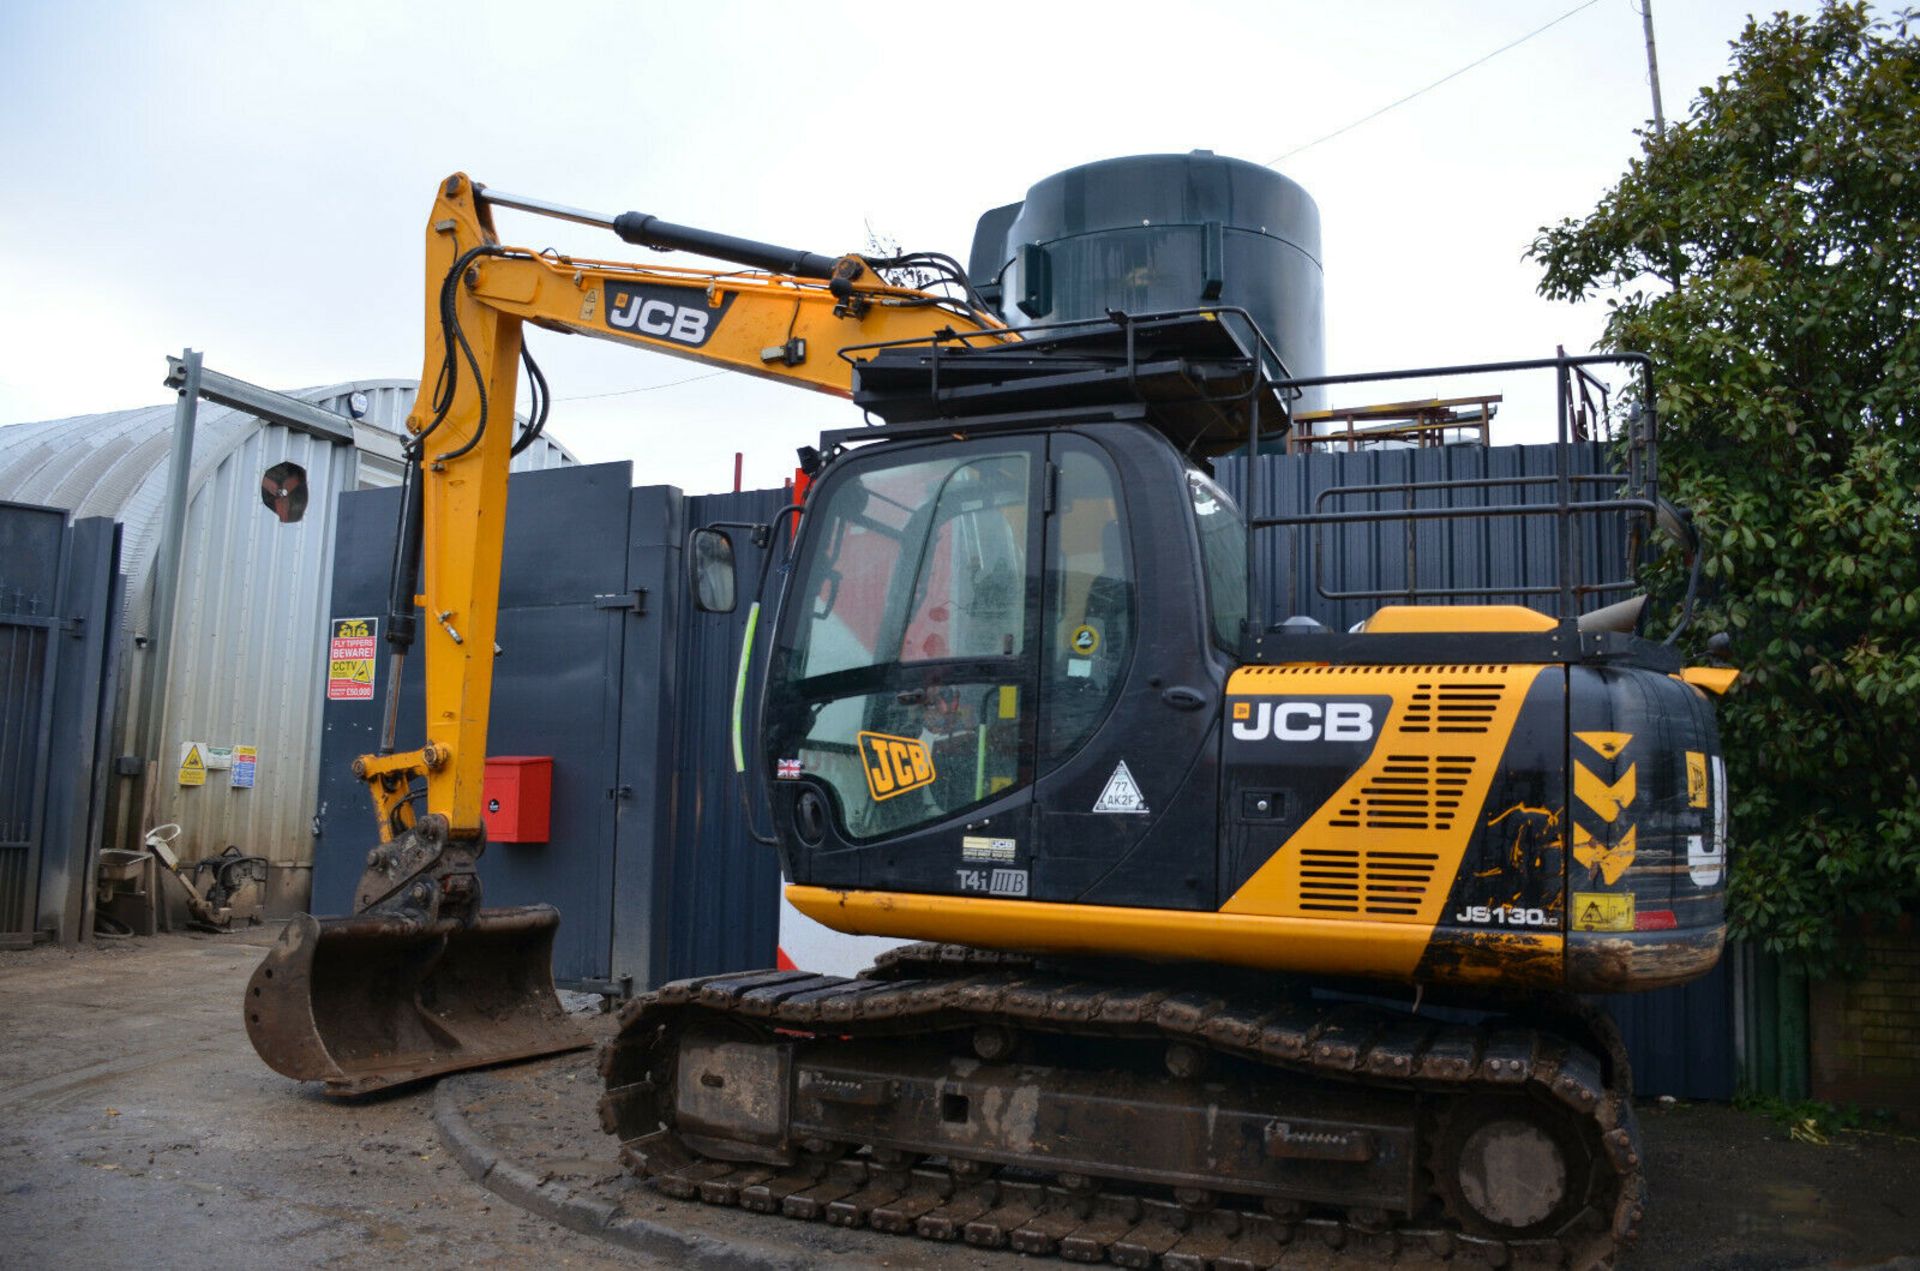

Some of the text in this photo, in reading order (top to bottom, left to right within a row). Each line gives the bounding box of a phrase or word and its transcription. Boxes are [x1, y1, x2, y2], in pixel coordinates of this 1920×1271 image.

[610, 296, 709, 344] JCB
[348, 639, 373, 647] TIPPERS
[1076, 631, 1092, 645] 2
[333, 647, 373, 658] BEWARE!
[332, 661, 357, 671] CCTV
[1232, 702, 1374, 741] JCB
[871, 738, 930, 792] JCB
[1115, 781, 1128, 791] 77
[1687, 755, 1727, 887] J
